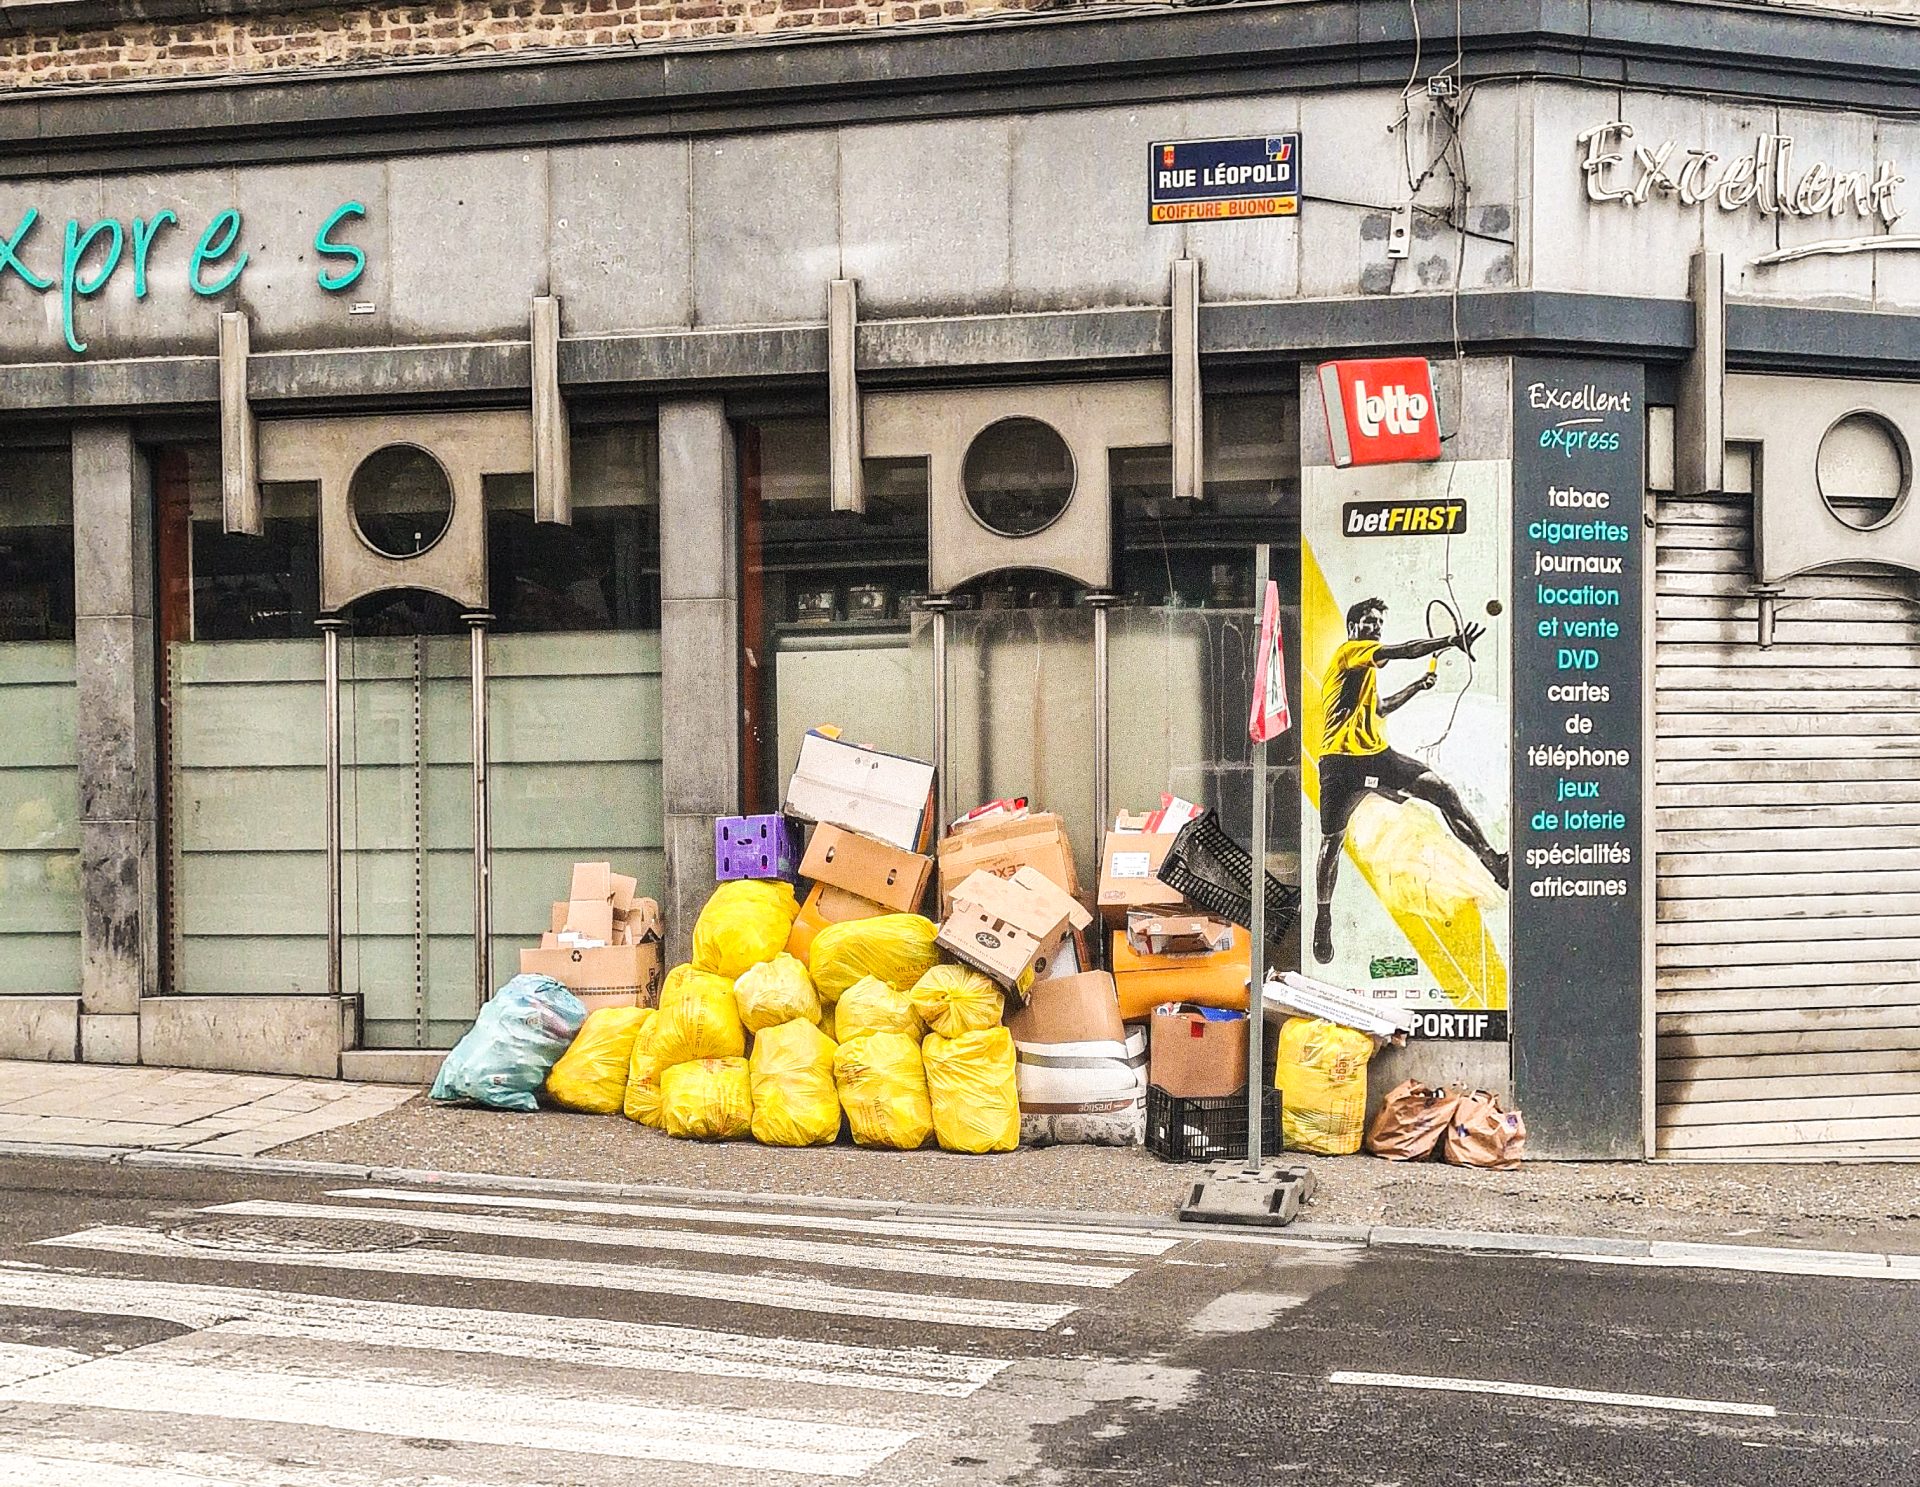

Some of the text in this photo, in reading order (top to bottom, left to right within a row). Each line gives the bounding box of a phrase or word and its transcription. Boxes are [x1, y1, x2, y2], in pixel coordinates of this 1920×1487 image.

[1159, 162, 1290, 189] RUE LÉOPOLD
[1577, 121, 1907, 220] Excellent
[1157, 199, 1276, 220] COIFFURE BUONO
[1355, 380, 1428, 437] lotto
[1528, 382, 1631, 413] Excellent
[1539, 428, 1620, 458] express
[1548, 485, 1610, 509] tabac
[1347, 505, 1463, 533] betFIRST
[1528, 519, 1629, 544] cigarettes
[1534, 550, 1623, 576] journaux
[1537, 583, 1620, 606] location
[1538, 616, 1620, 638] et vente
[1557, 649, 1600, 669] DVD
[1547, 681, 1610, 702] cartes
[1565, 713, 1593, 734] de
[1527, 743, 1630, 770] téléphone
[1557, 777, 1600, 802] jeux
[1531, 809, 1626, 830] de loterie
[1526, 841, 1631, 869] spécialités
[1529, 876, 1628, 898] africaines
[1410, 1013, 1489, 1038] PORTIF
[1078, 1102, 1113, 1114] prestige
